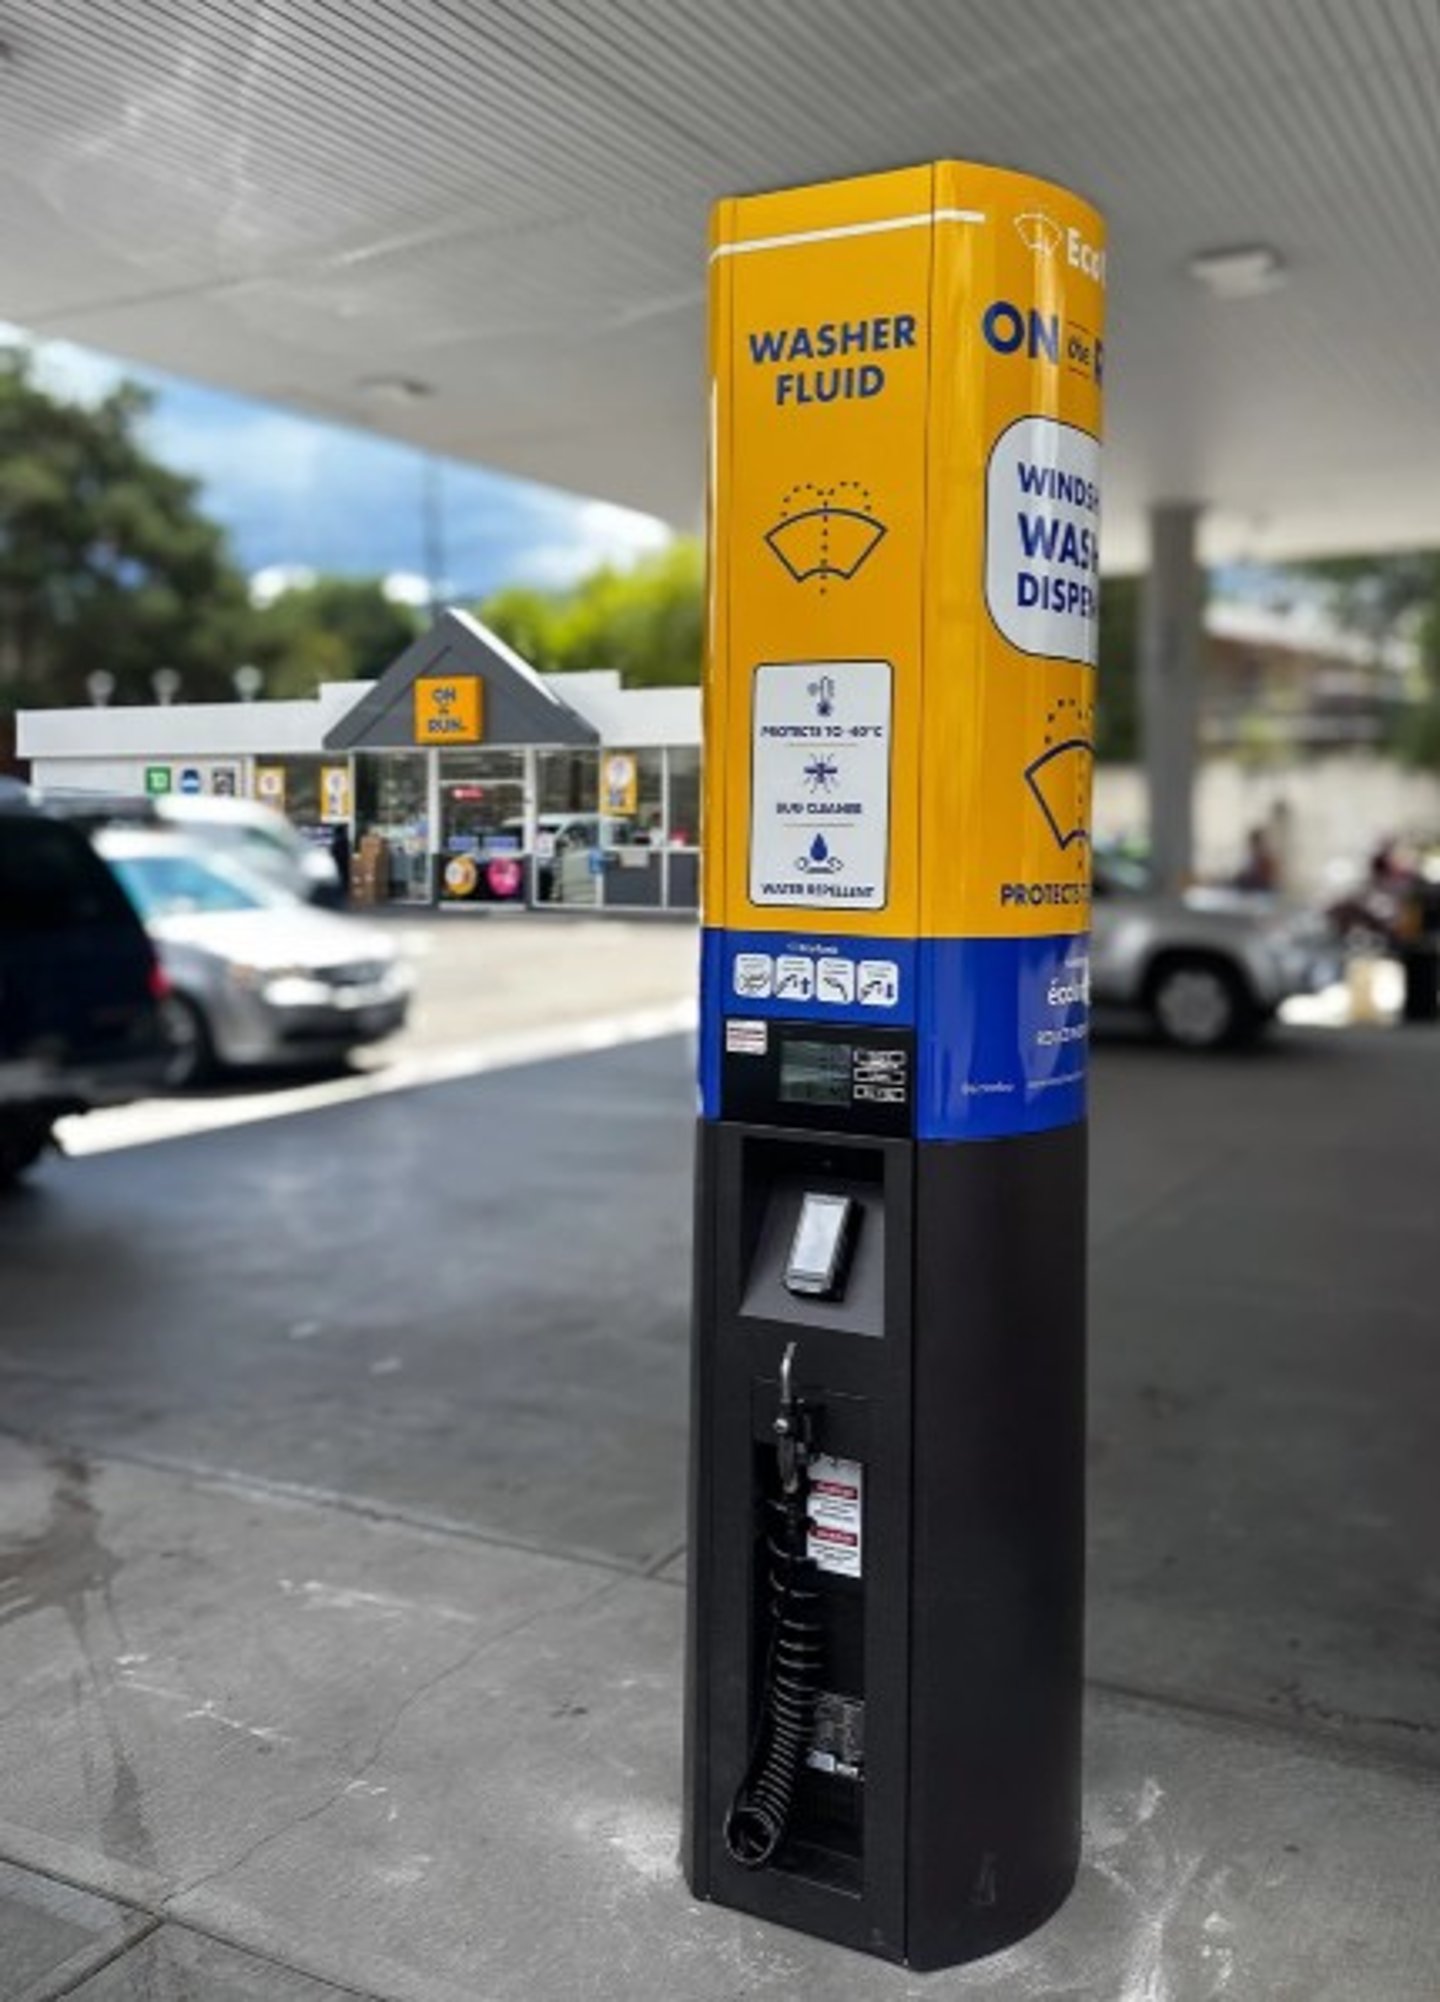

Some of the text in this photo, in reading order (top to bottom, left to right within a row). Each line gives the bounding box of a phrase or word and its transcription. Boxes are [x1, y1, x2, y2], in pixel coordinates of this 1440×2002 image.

[748, 314, 916, 364] WASHER
[983, 301, 1060, 365] ON
[776, 365, 885, 405] FLUID
[761, 725, 821, 737] PROTECTS
[824, 725, 842, 737] TO
[761, 883, 875, 898] WATER REPELLENT
